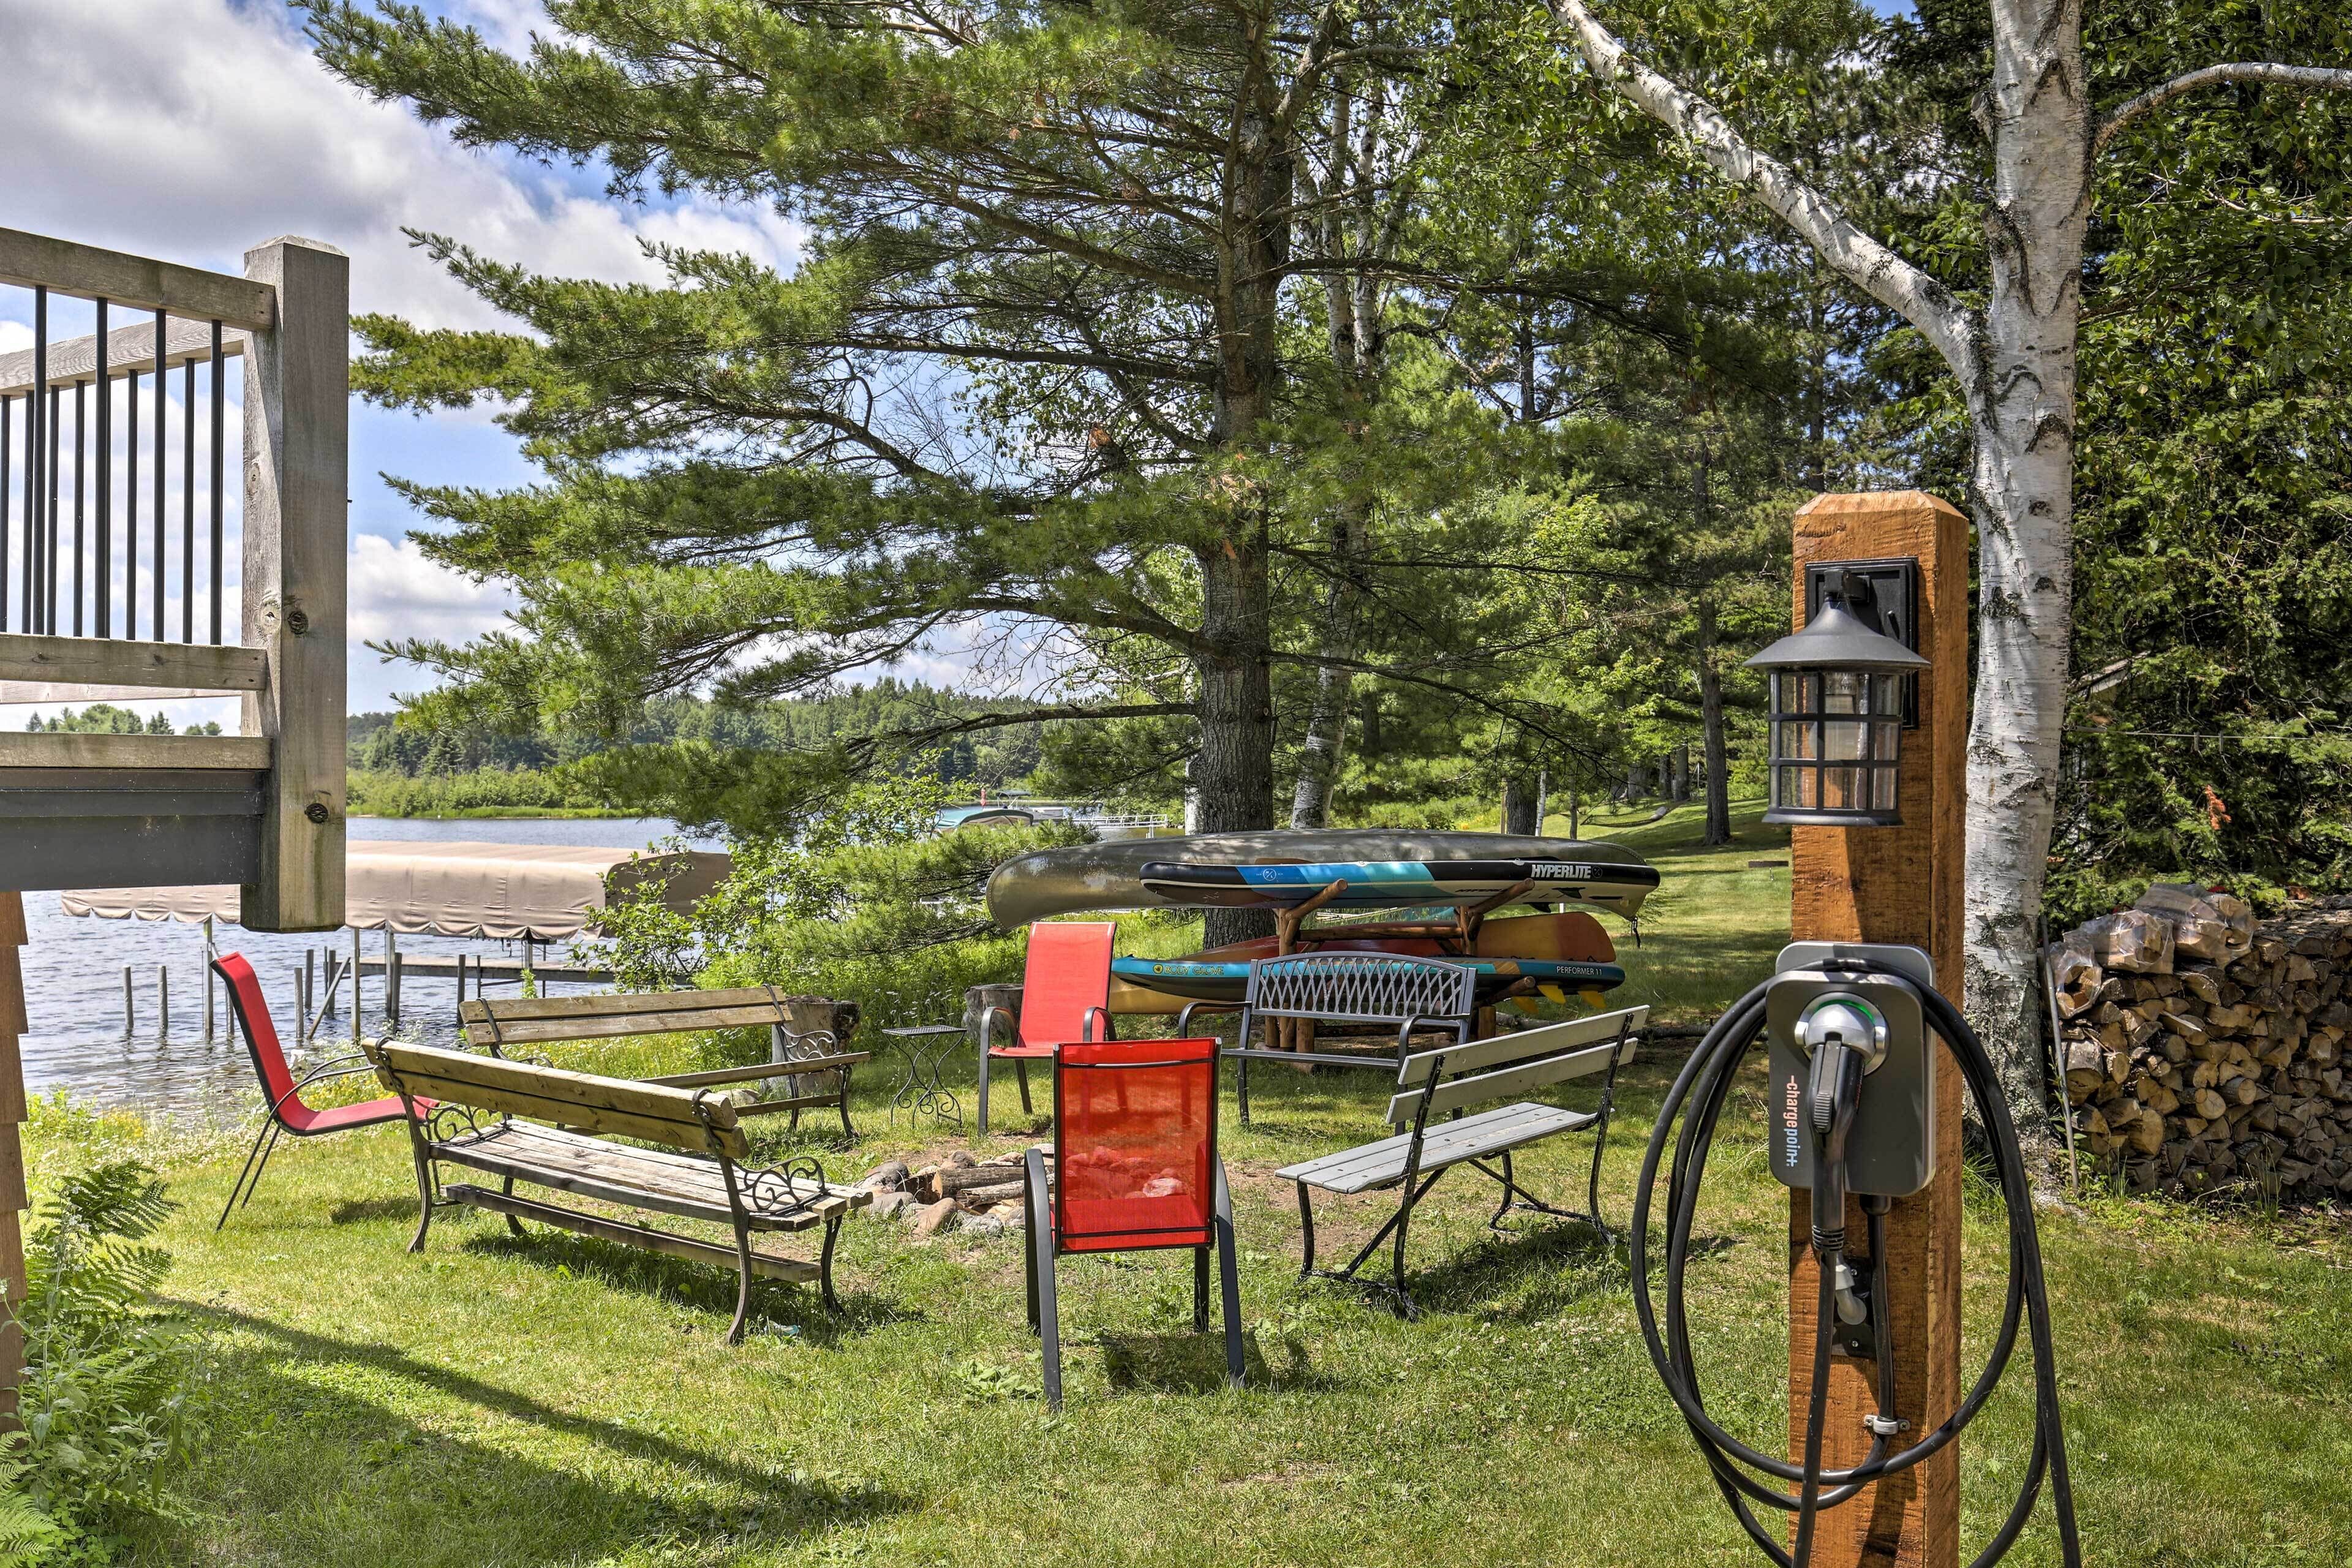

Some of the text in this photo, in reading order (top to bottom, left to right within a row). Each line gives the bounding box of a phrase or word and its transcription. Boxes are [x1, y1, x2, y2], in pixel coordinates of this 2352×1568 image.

[1531, 864, 1591, 879] HYPERLITE
[1164, 965, 1224, 976] BODY GLOVE
[1556, 966, 1594, 975] PERFORMER
[1783, 1076, 1801, 1167] chargepoint
